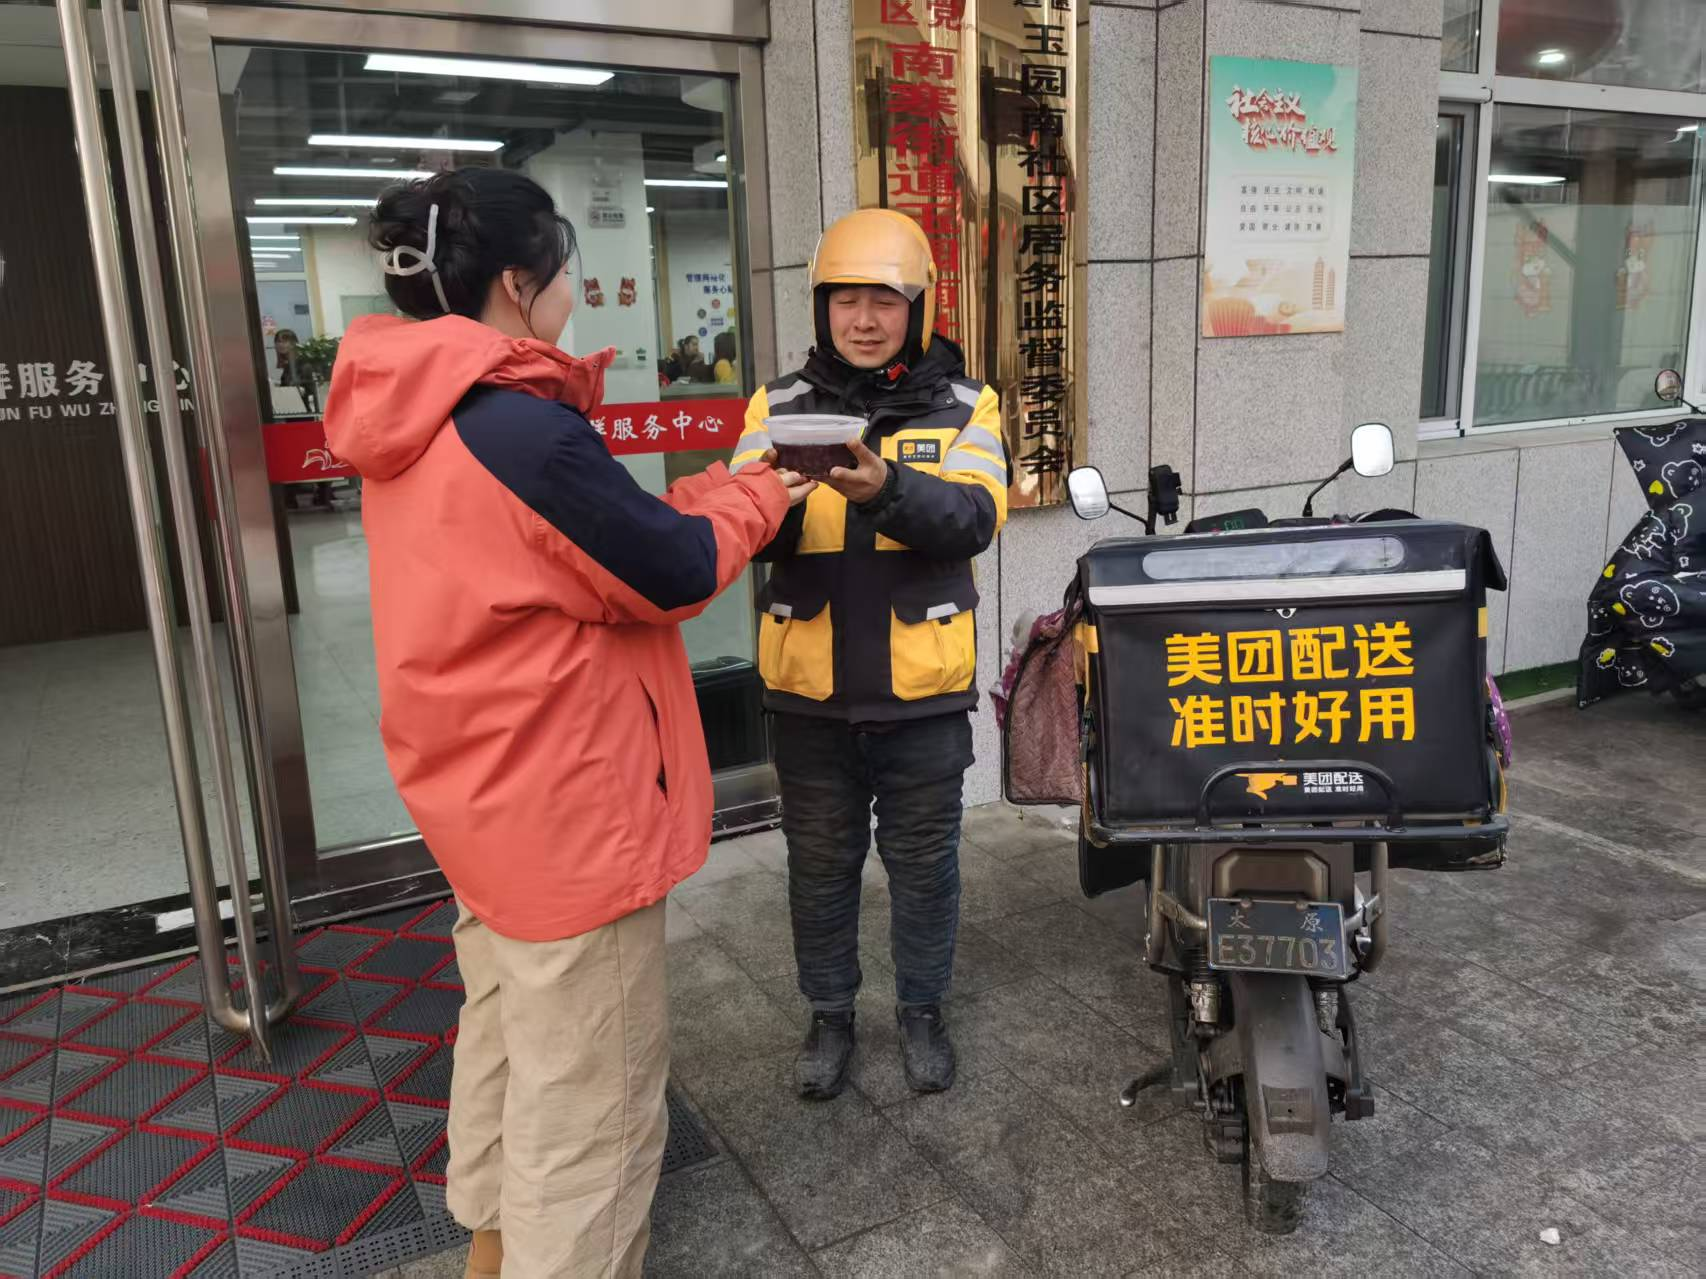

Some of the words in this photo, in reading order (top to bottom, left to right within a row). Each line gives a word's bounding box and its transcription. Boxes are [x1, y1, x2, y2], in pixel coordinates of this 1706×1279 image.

[1226, 84, 1306, 121] 社会主义
[1241, 119, 1337, 152] 核心价值观
[29, 405, 52, 419] FU
[60, 403, 91, 417] WU
[1165, 620, 1415, 687] 美团配送
[1168, 687, 1416, 749] 准时好用
[1303, 771, 1364, 785] 美团配送
[1217, 933, 1338, 970] E37703
